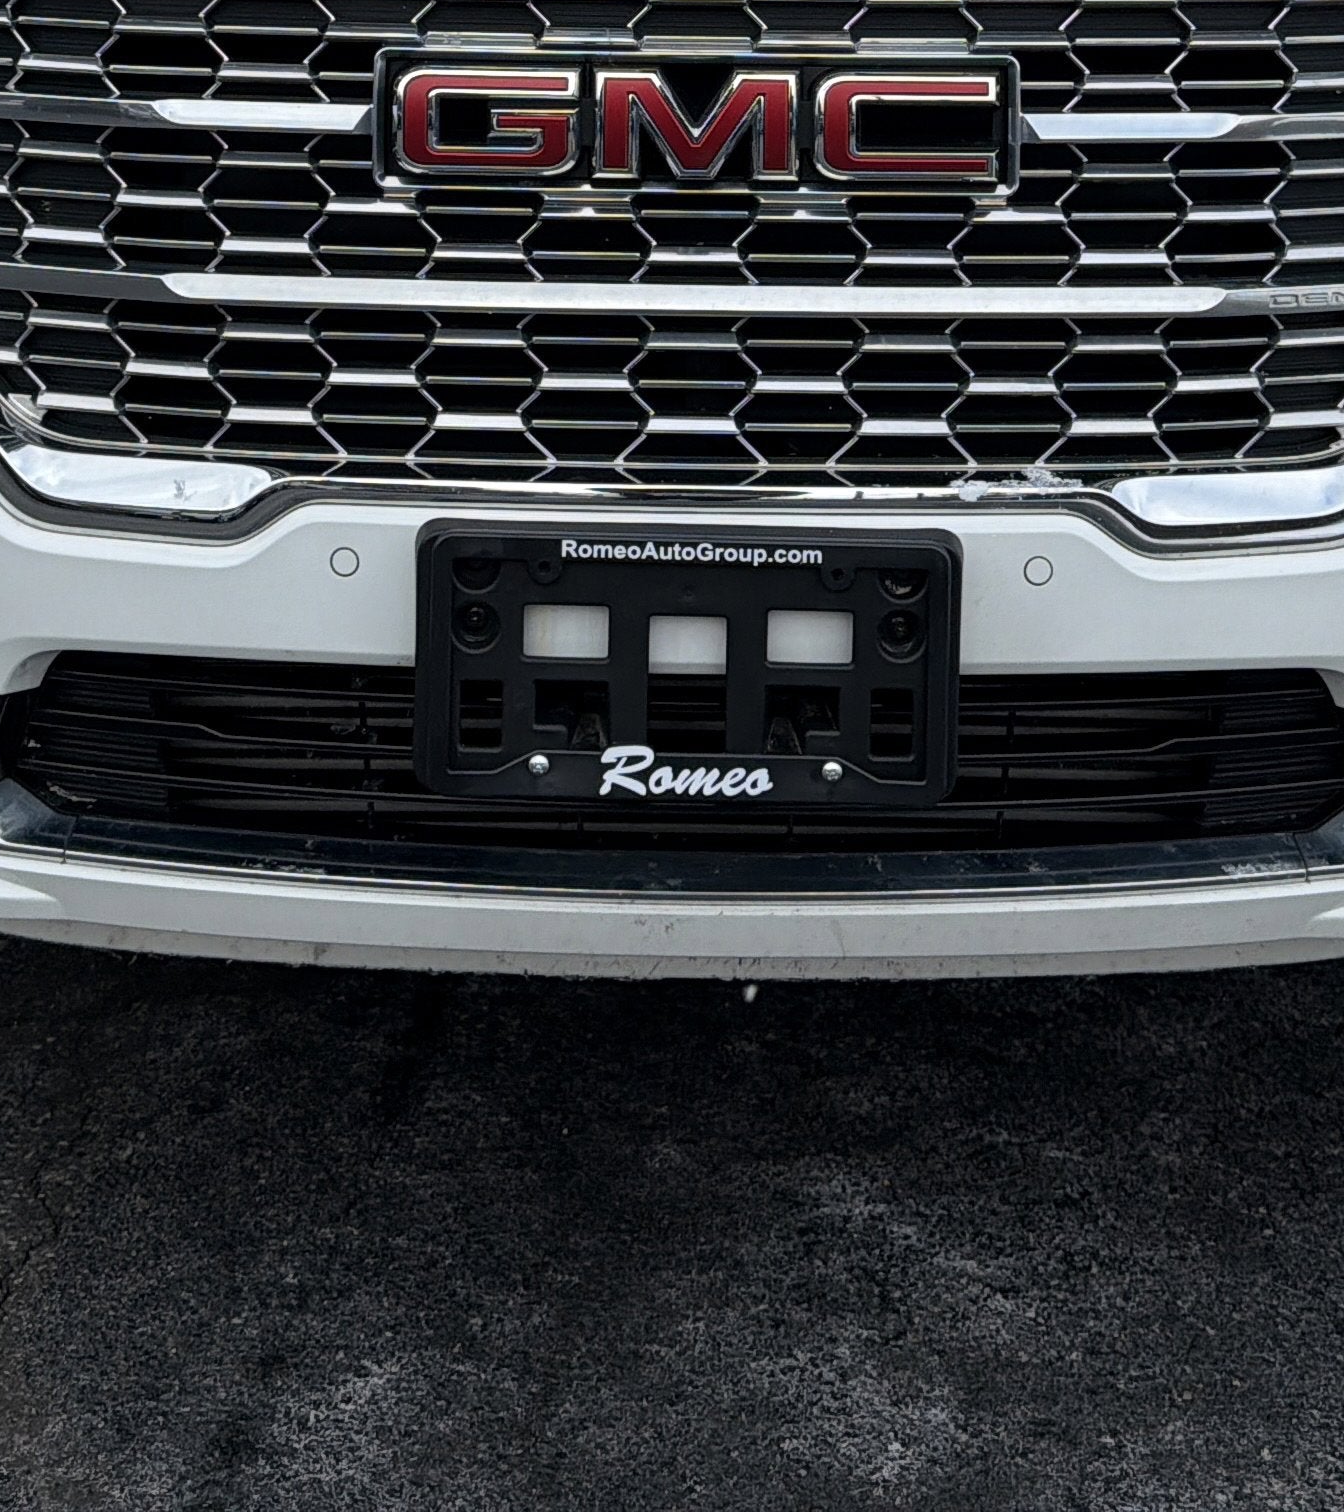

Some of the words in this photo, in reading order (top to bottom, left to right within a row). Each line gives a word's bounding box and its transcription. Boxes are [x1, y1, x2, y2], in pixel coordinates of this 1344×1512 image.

[392, 67, 1001, 182] GMC
[561, 539, 823, 566] RomeoAutoGroup.com
[599, 744, 774, 797] Romeo
